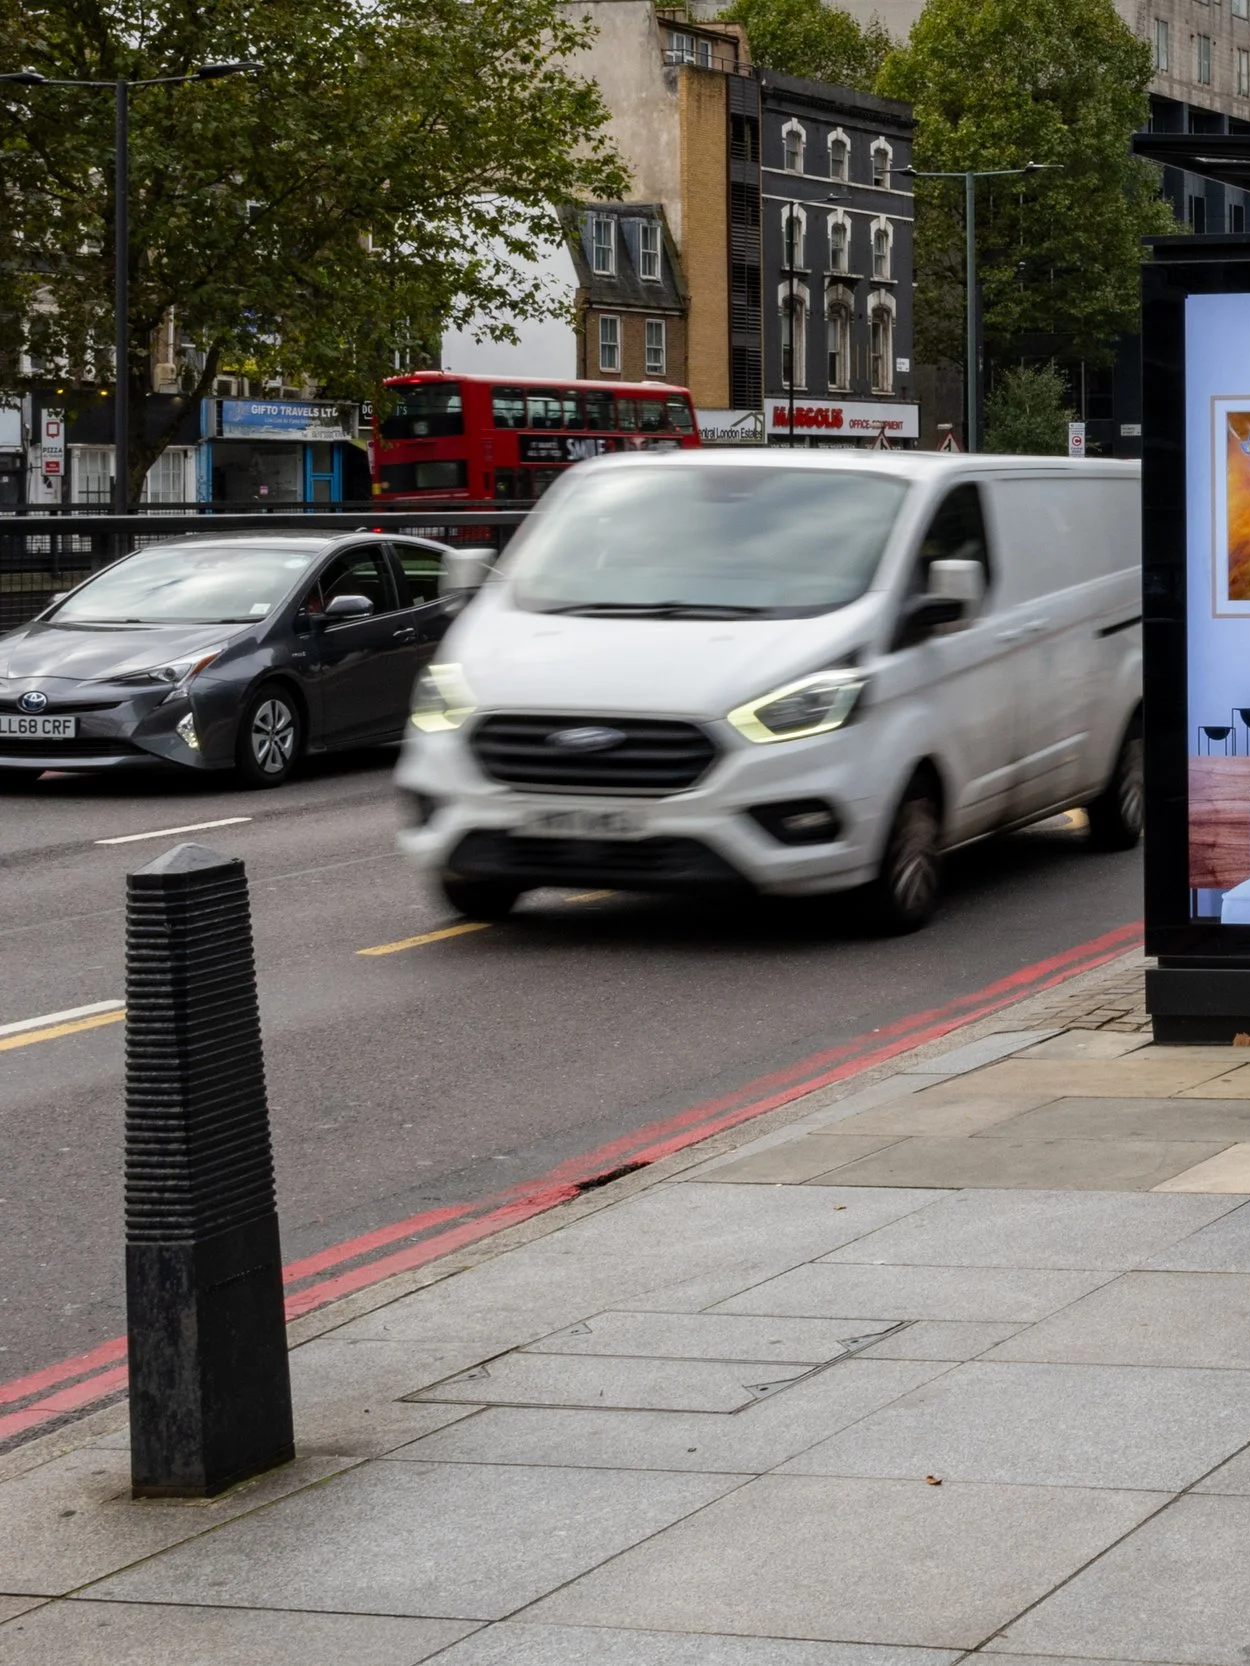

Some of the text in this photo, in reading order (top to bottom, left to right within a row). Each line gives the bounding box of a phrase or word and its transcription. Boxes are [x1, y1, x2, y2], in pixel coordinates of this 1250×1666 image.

[251, 404, 278, 416] GIFTO
[280, 406, 319, 417] TRAVELS
[772, 406, 844, 430] MARGOLIS
[849, 419, 869, 429] OFFICE
[698, 427, 763, 439] entral London Estates
[0, 718, 72, 735] LL68 CRF
